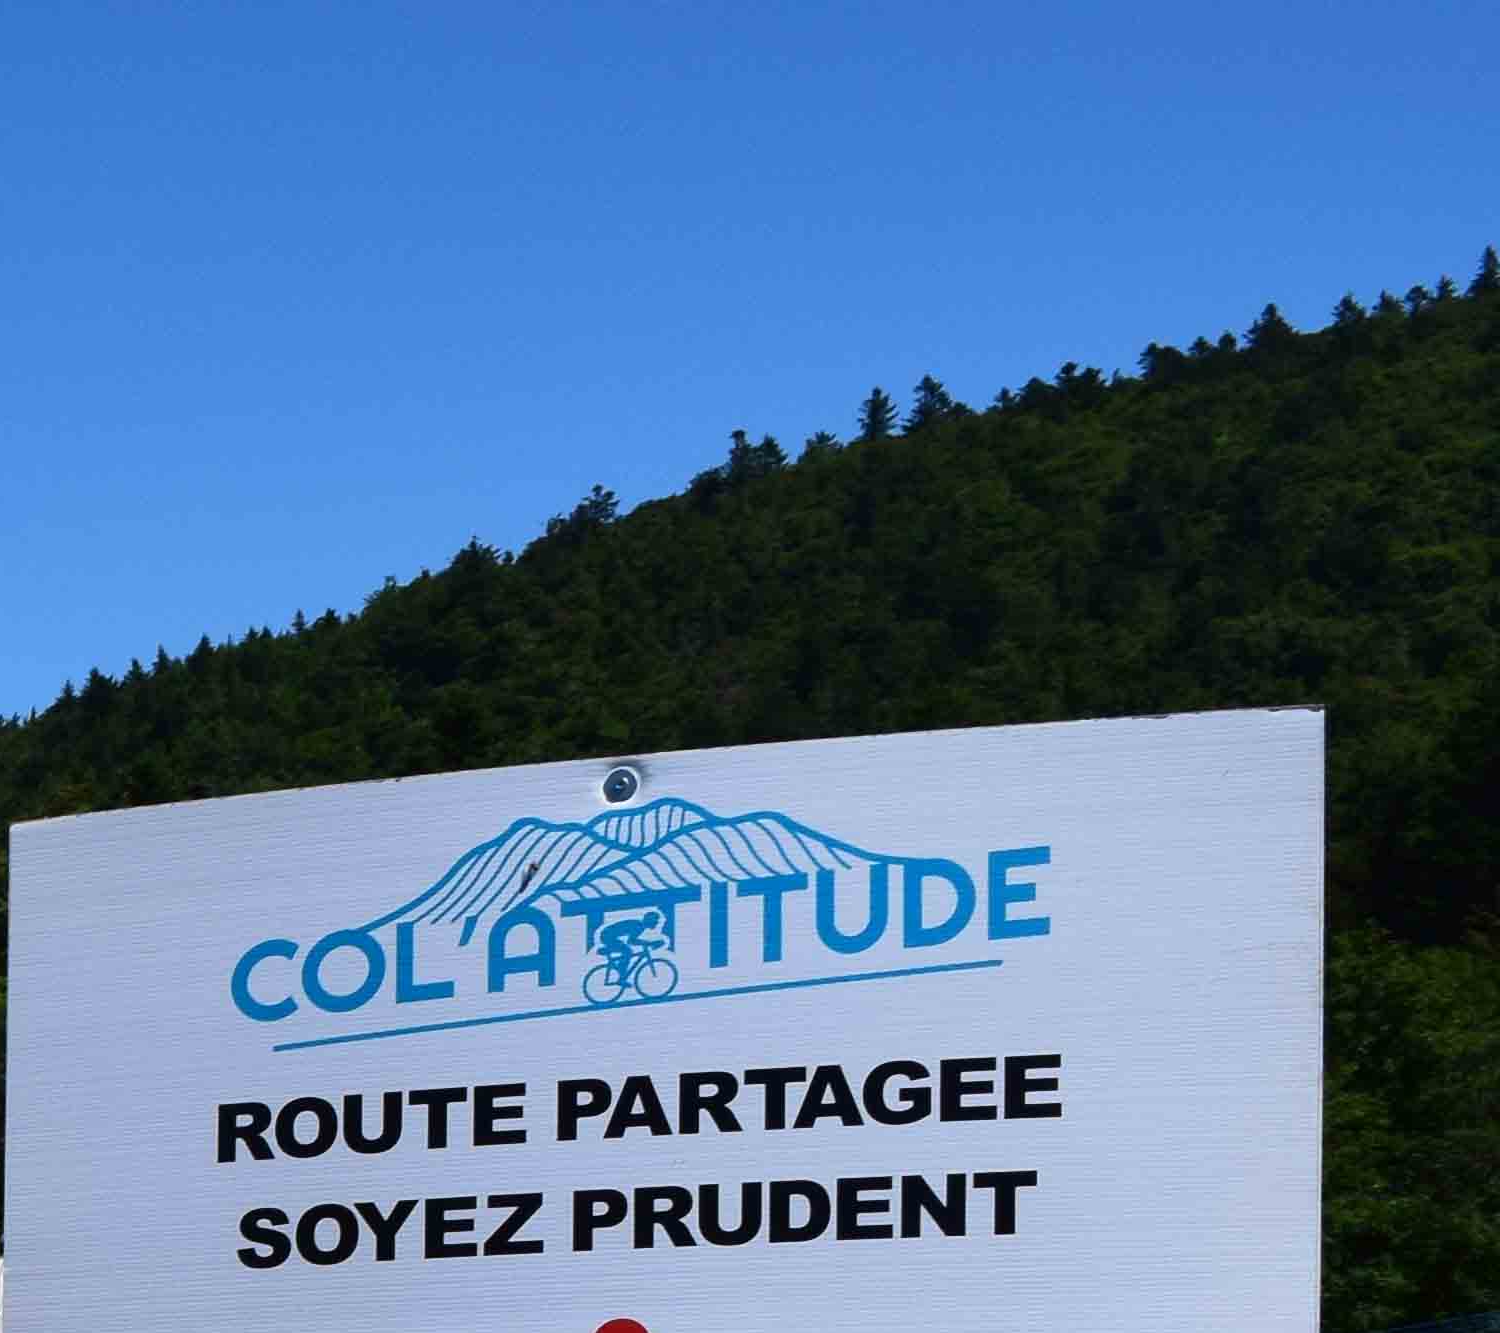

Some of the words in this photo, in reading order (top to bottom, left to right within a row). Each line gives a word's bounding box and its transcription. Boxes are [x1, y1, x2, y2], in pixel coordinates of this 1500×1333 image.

[229, 844, 1053, 1024] COL'ATTITUDE
[216, 1081, 528, 1165] ROUTE
[555, 1053, 1063, 1142] PARTAGEE
[236, 1191, 545, 1270] SOYEZ
[571, 1169, 1039, 1253] PRUDENT
